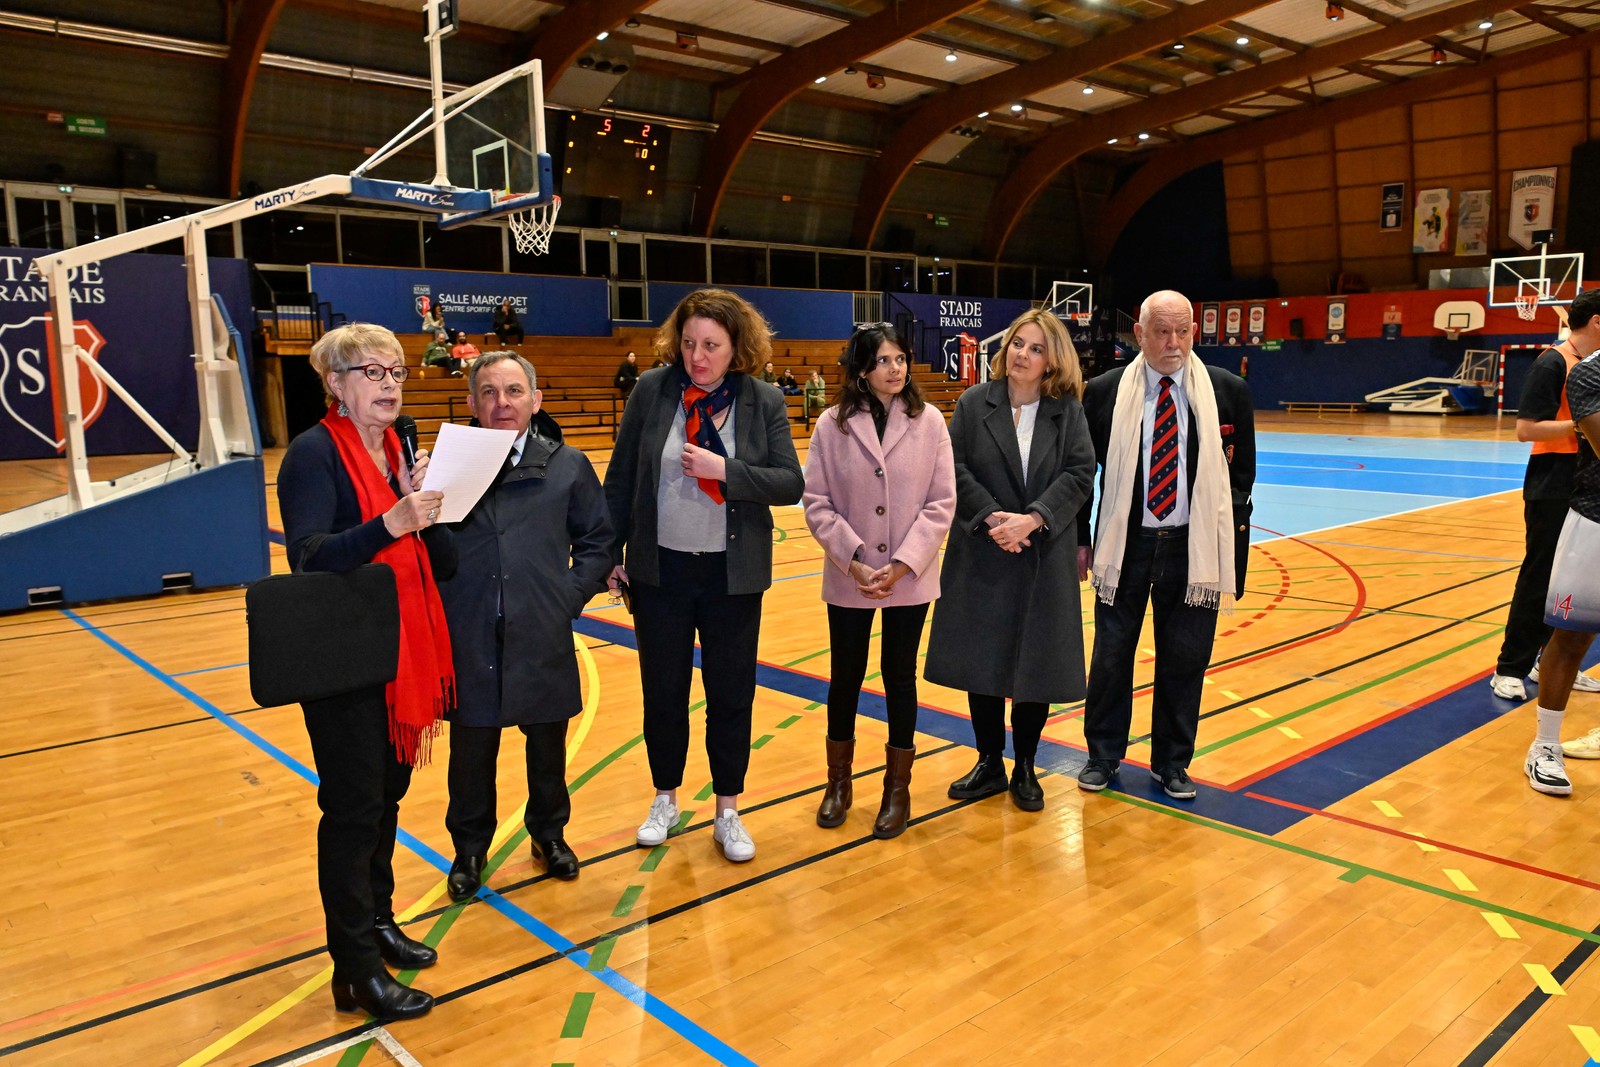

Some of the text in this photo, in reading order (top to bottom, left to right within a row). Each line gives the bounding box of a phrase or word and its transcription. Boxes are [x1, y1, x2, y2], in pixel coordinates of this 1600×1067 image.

[604, 119, 611, 131] 5
[642, 125, 650, 137] 2
[1513, 174, 1556, 192] CHAMPIONNES
[255, 190, 296, 211] MARTY
[395, 187, 437, 203] MARTY
[438, 293, 528, 306] SALLE MARCADET
[940, 300, 982, 317] STADE
[1553, 593, 1574, 620] 14
